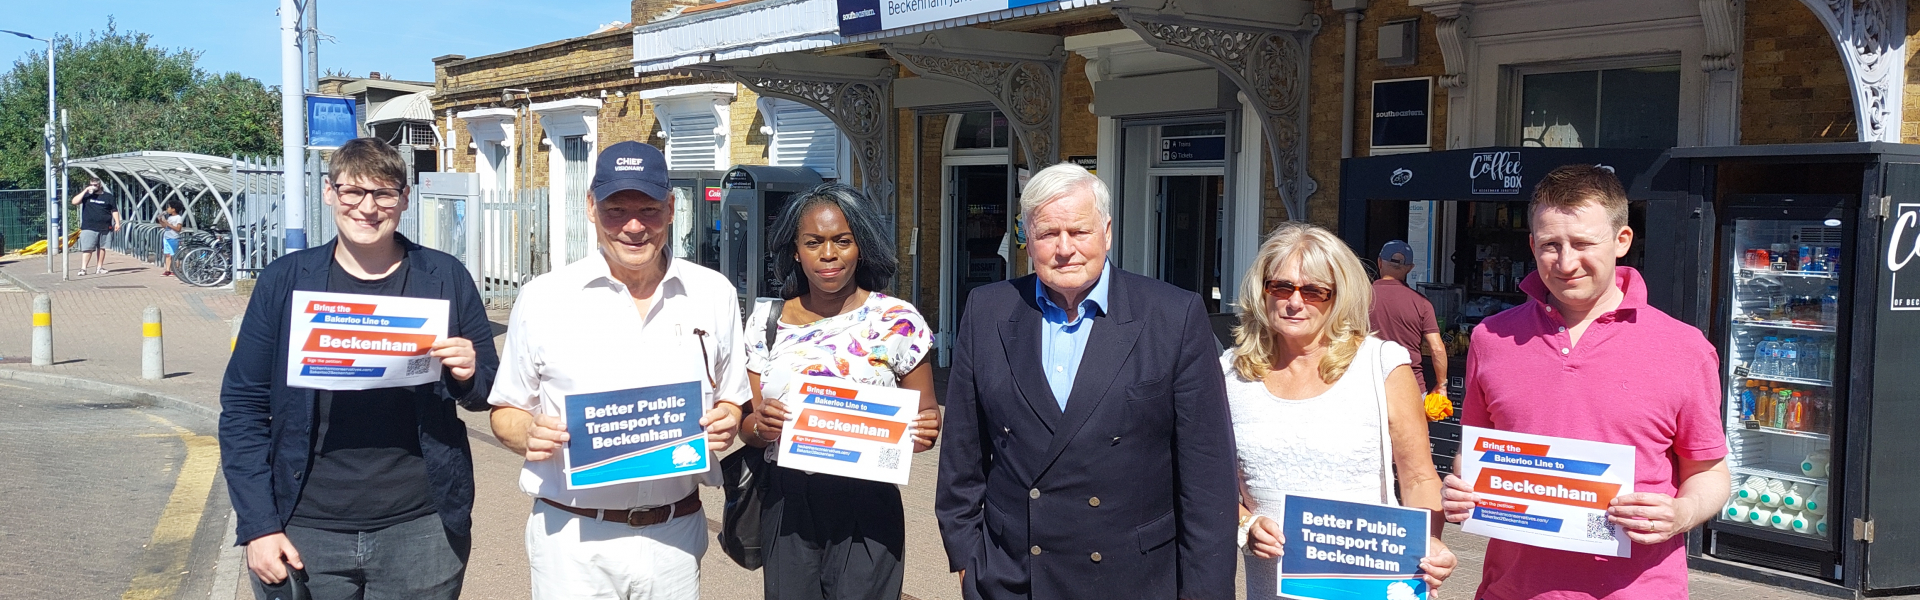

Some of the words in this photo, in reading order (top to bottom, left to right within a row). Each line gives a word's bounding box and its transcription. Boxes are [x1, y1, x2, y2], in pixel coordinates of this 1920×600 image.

[616, 157, 643, 166] CHIEF
[1469, 151, 1523, 181] Coffee
[1482, 154, 1492, 162] THE
[1503, 175, 1522, 188] BOX
[313, 303, 336, 313] Bring
[337, 304, 351, 313] the
[324, 315, 361, 324] Bakerloo
[362, 317, 379, 325] Line
[380, 318, 390, 326] to
[319, 334, 417, 352] Beckenham
[806, 385, 825, 396] Bring
[825, 387, 836, 396] the
[584, 402, 635, 420] Better
[637, 395, 686, 413] Public
[814, 396, 844, 407] Bakerloo
[845, 401, 860, 410] Line
[860, 403, 868, 411] to
[585, 414, 661, 435] Transport
[662, 411, 687, 424] for
[807, 414, 890, 438] Beckenham
[592, 427, 683, 450] Beckenham
[1482, 440, 1506, 452] Bring
[1506, 443, 1521, 453] the
[1494, 454, 1533, 466] Bakerloo
[1534, 459, 1553, 469] Line
[1555, 461, 1565, 470] to
[1490, 475, 1598, 503] Beckenham
[1302, 511, 1353, 530] Better
[1356, 517, 1407, 538] Public
[1301, 528, 1378, 552] Transport
[1380, 539, 1406, 556] for
[1306, 545, 1400, 573] Beckenham
